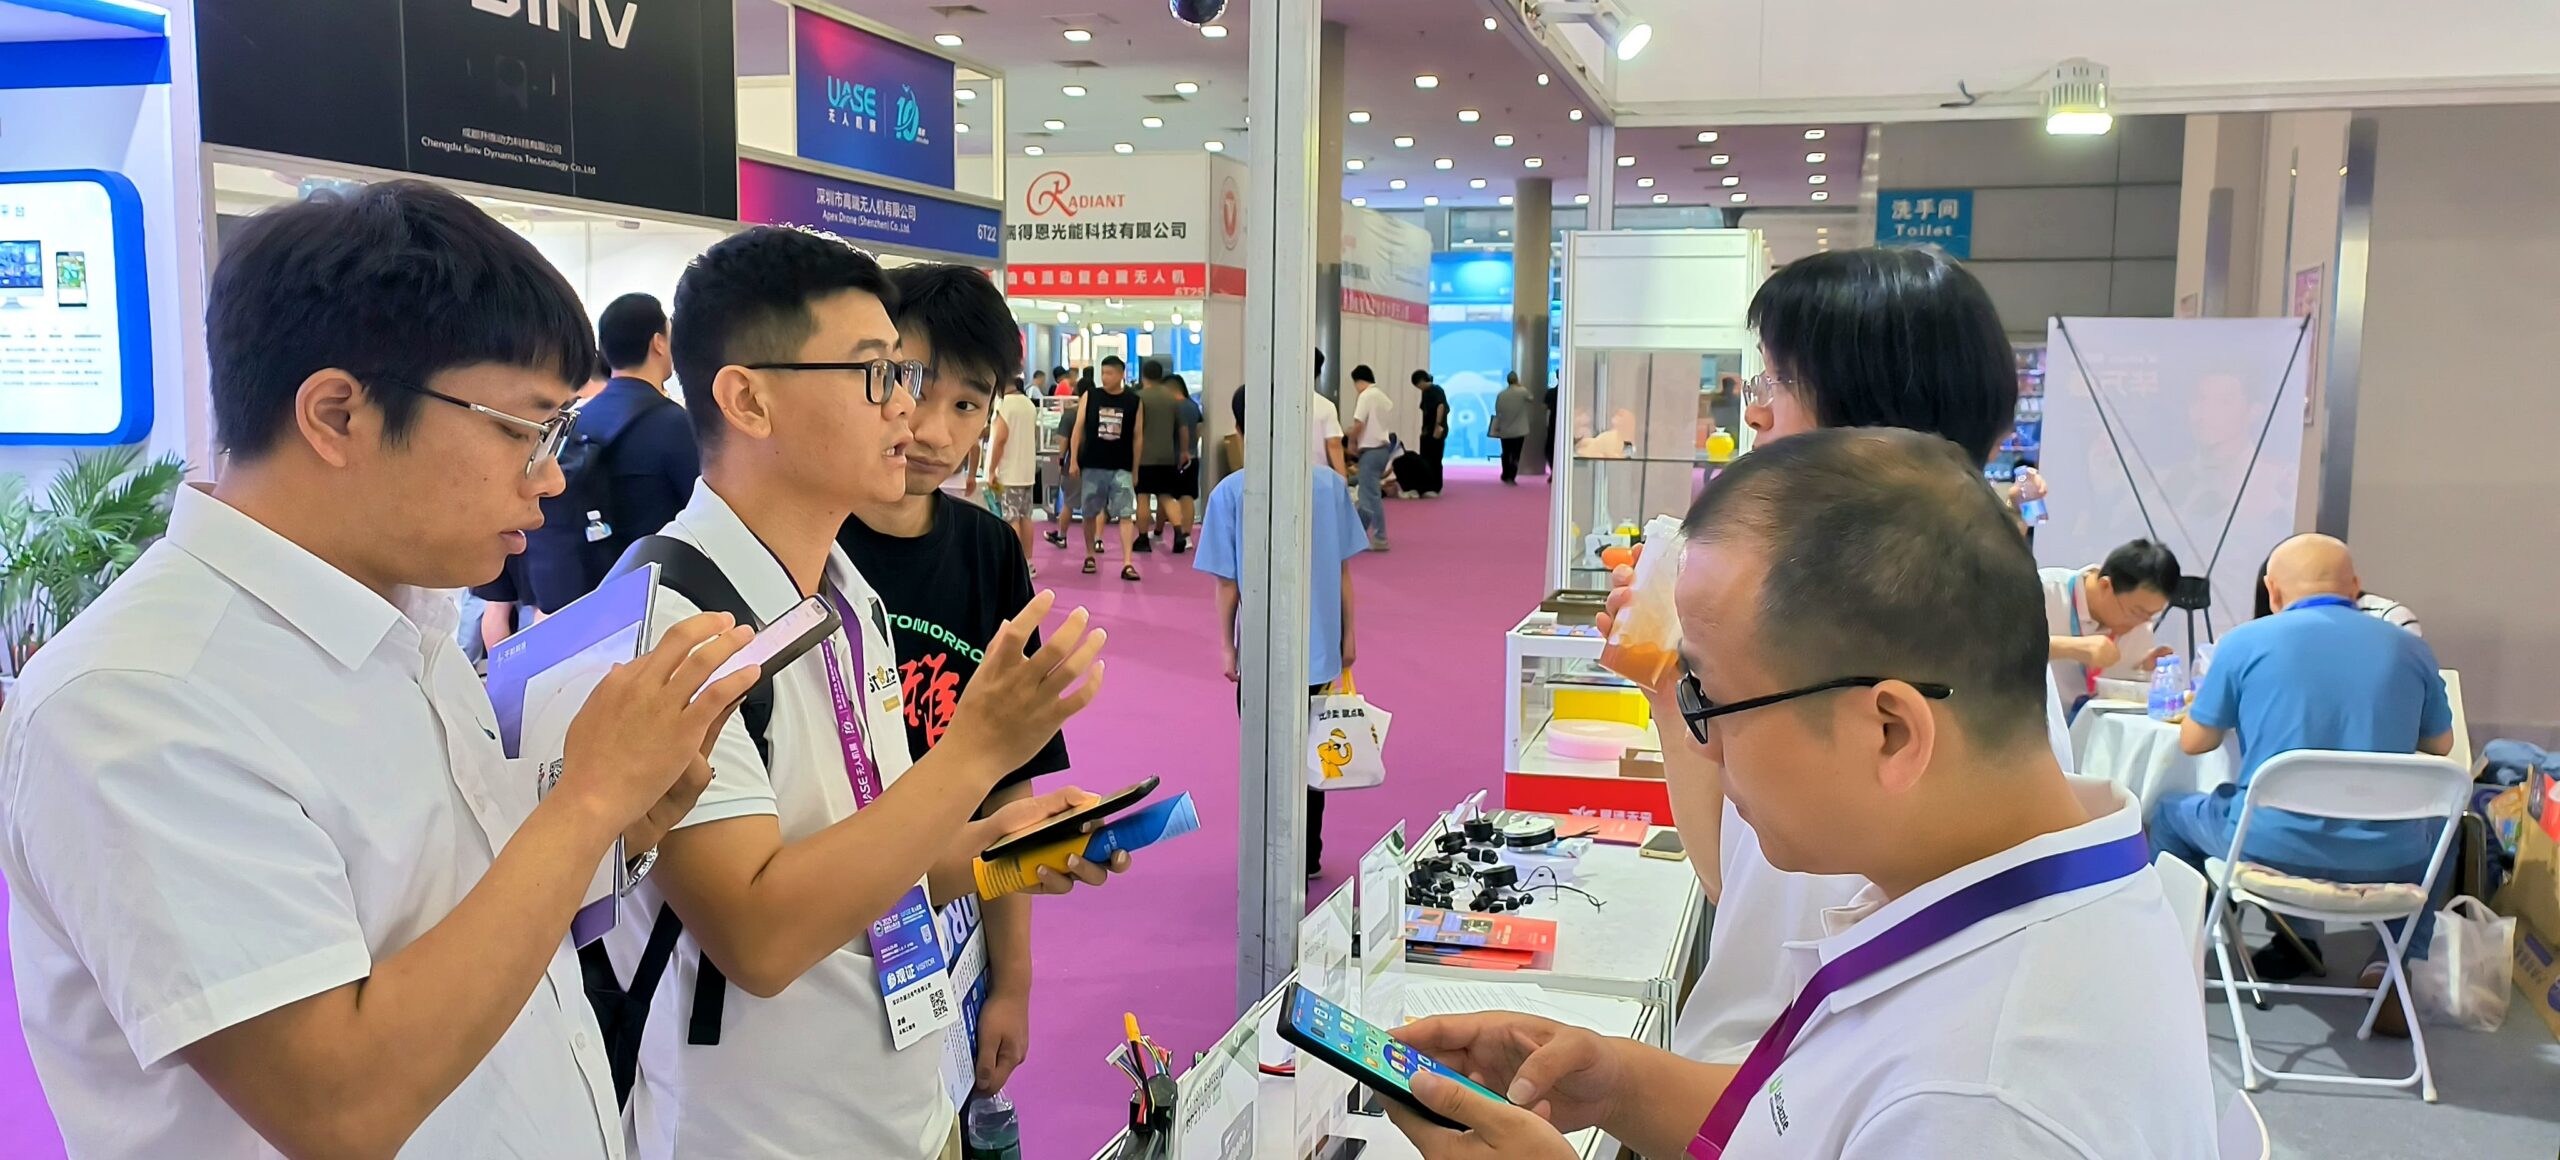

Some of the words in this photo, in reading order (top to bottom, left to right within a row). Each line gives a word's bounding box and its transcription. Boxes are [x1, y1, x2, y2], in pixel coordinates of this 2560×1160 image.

[471, 0, 638, 49] nv
[828, 75, 876, 117] UASE
[421, 136, 462, 152] Chengdu
[484, 147, 523, 163] Dynamics
[525, 154, 569, 171] Technology
[1026, 170, 1126, 218] RADIANT
[1892, 198, 1958, 220] 洗手间
[822, 209, 838, 223] Apex
[839, 212, 857, 225] Drone
[977, 224, 997, 243] 6T22
[1895, 223, 1953, 237] Toilet
[887, 963, 917, 990] 参观证
[916, 957, 936, 973] VISITOR
